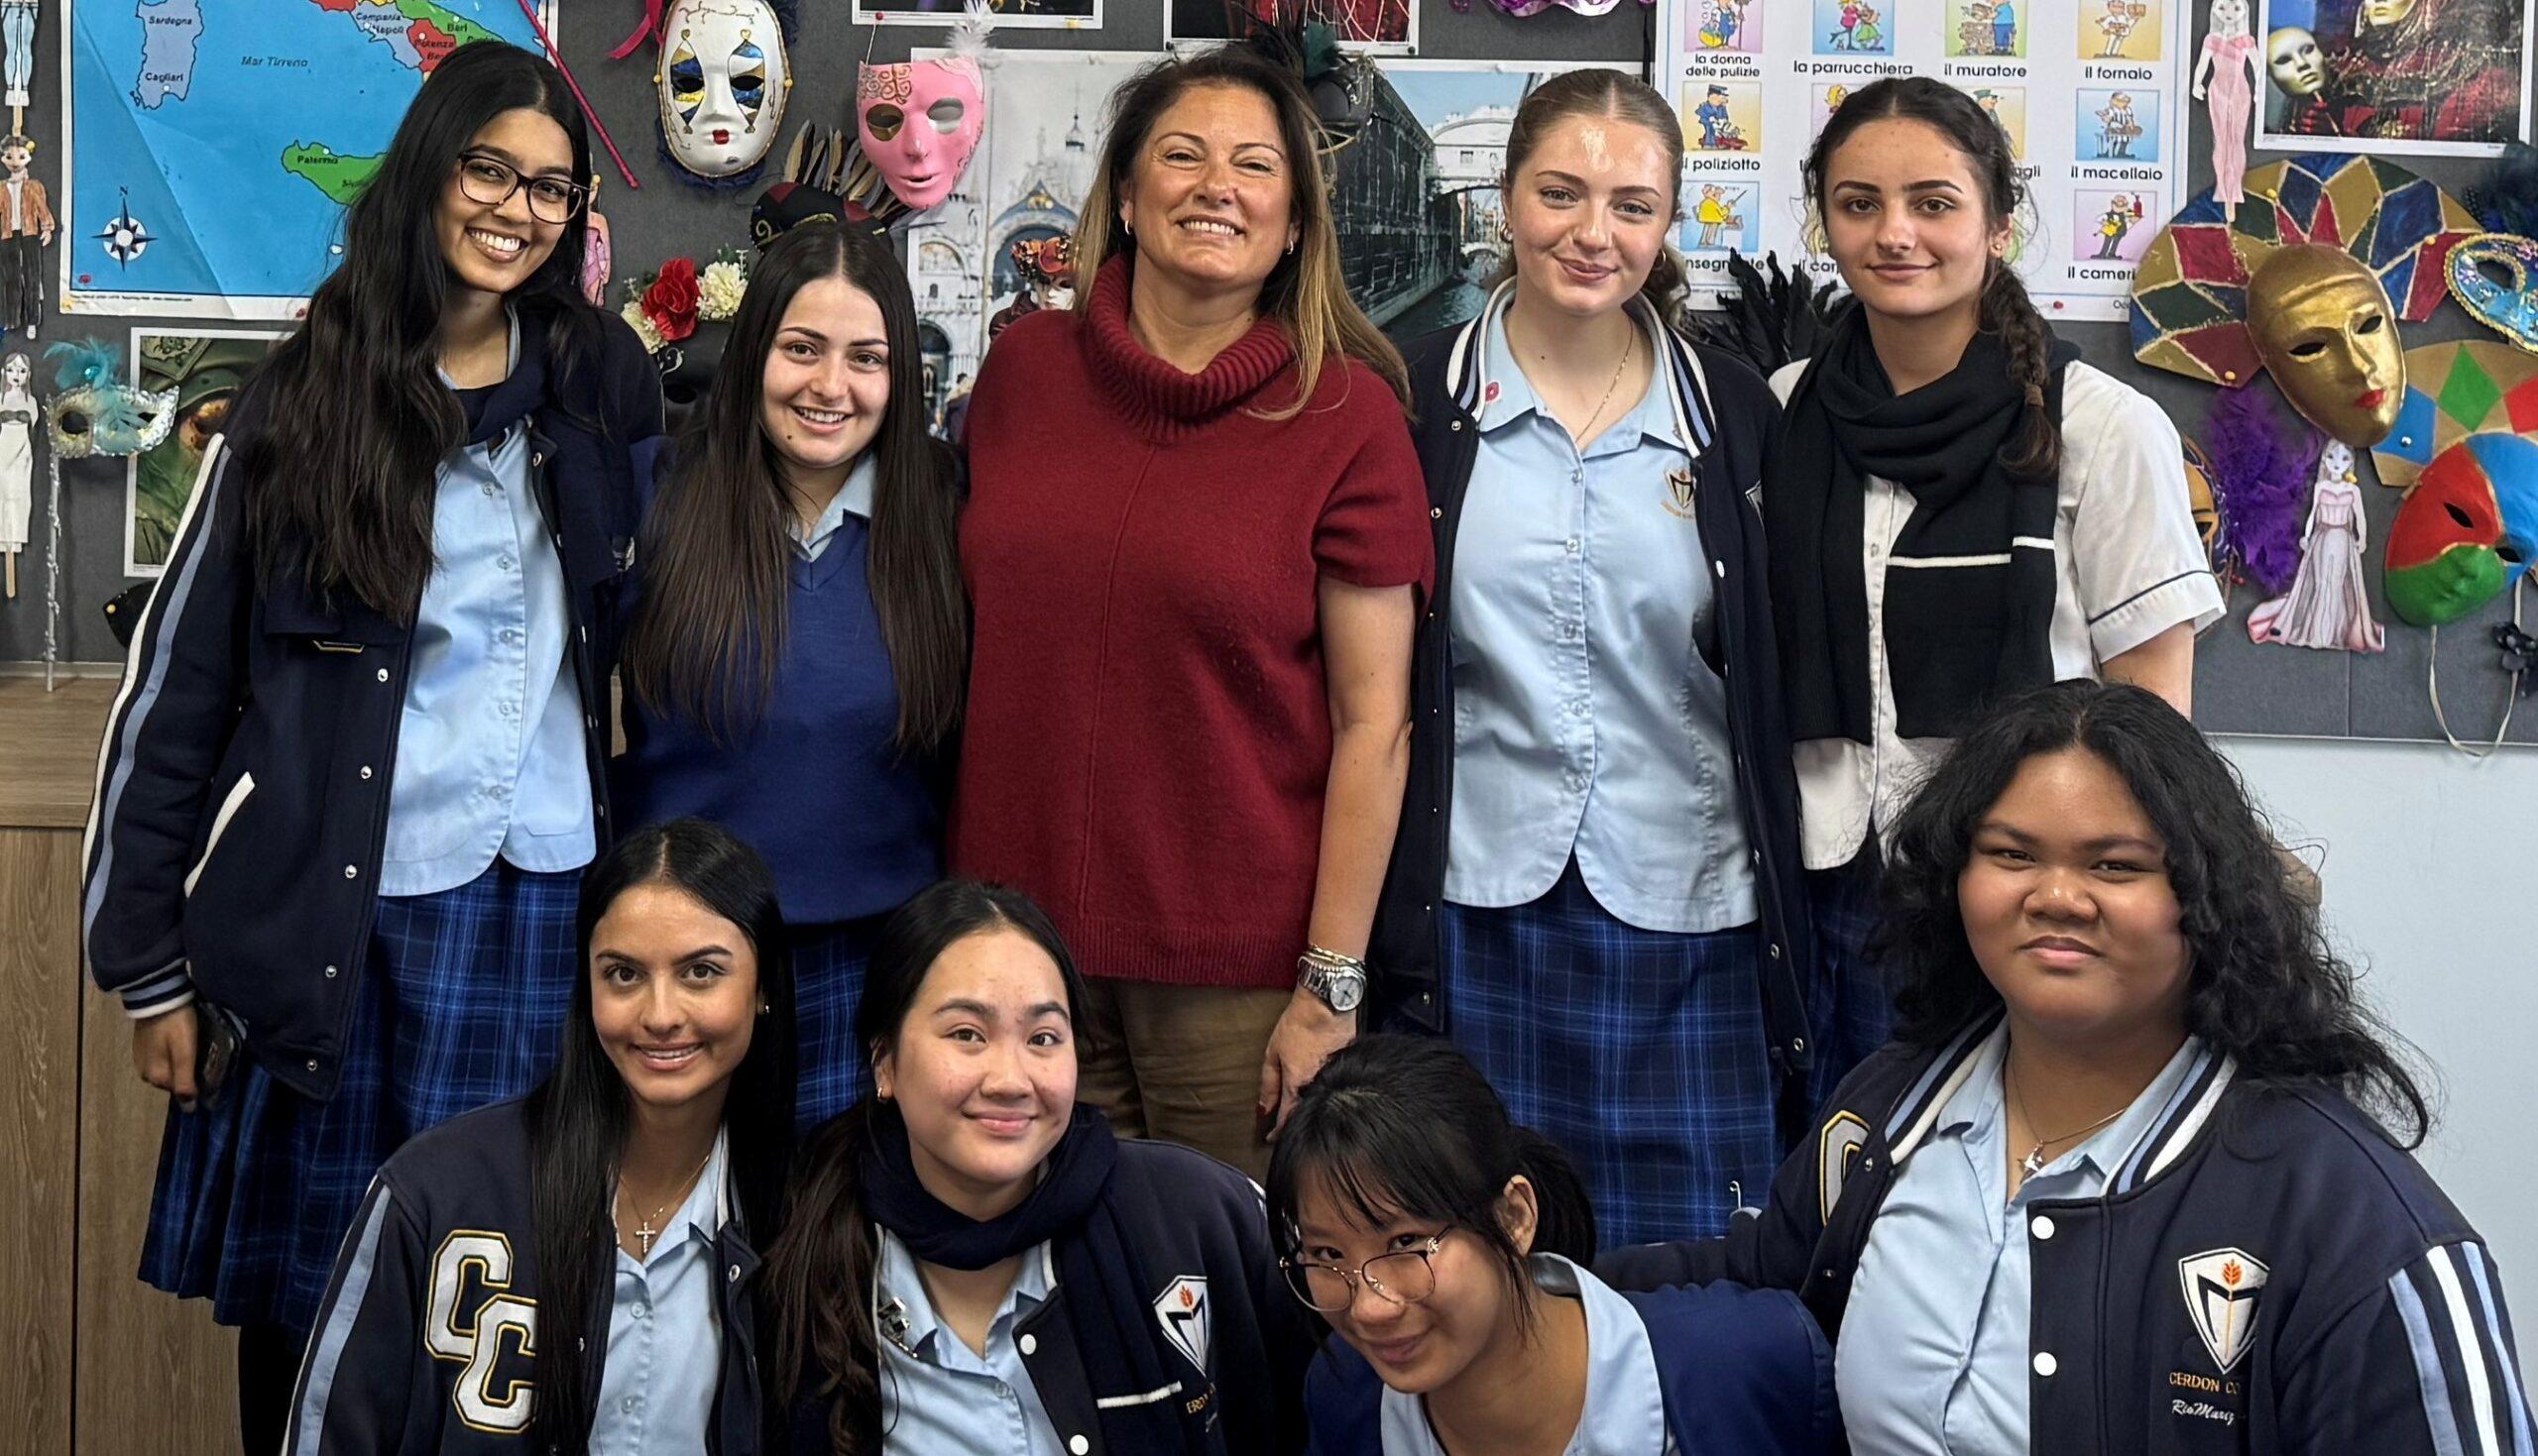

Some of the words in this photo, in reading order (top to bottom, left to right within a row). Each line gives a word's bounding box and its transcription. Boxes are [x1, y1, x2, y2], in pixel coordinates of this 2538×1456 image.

[149, 16, 192, 27] Sardegna
[355, 12, 402, 22] Campania
[447, 23, 468, 33] Bari
[241, 56, 263, 65] Mar
[267, 56, 308, 67] Tirreno
[1695, 54, 1706, 64] la
[1710, 55, 1751, 65] donna
[1685, 66, 1716, 77] delle
[1720, 66, 1760, 78] pulizie
[1793, 59, 1807, 73] la
[1812, 61, 1913, 75] parrucchiera
[1944, 63, 1952, 76] il
[1956, 65, 2027, 77] muratore
[2085, 66, 2093, 78] il
[2097, 66, 2152, 80] fornaio
[145, 72, 183, 82] Cagliari
[297, 155, 338, 165] Palermo
[1692, 158, 1761, 171] poliziotto
[2070, 166, 2078, 178] il
[2083, 167, 2163, 180] macellaio
[2067, 267, 2075, 279] il
[2079, 269, 2135, 280] cameri
[2169, 1372, 2221, 1393] CERDON
